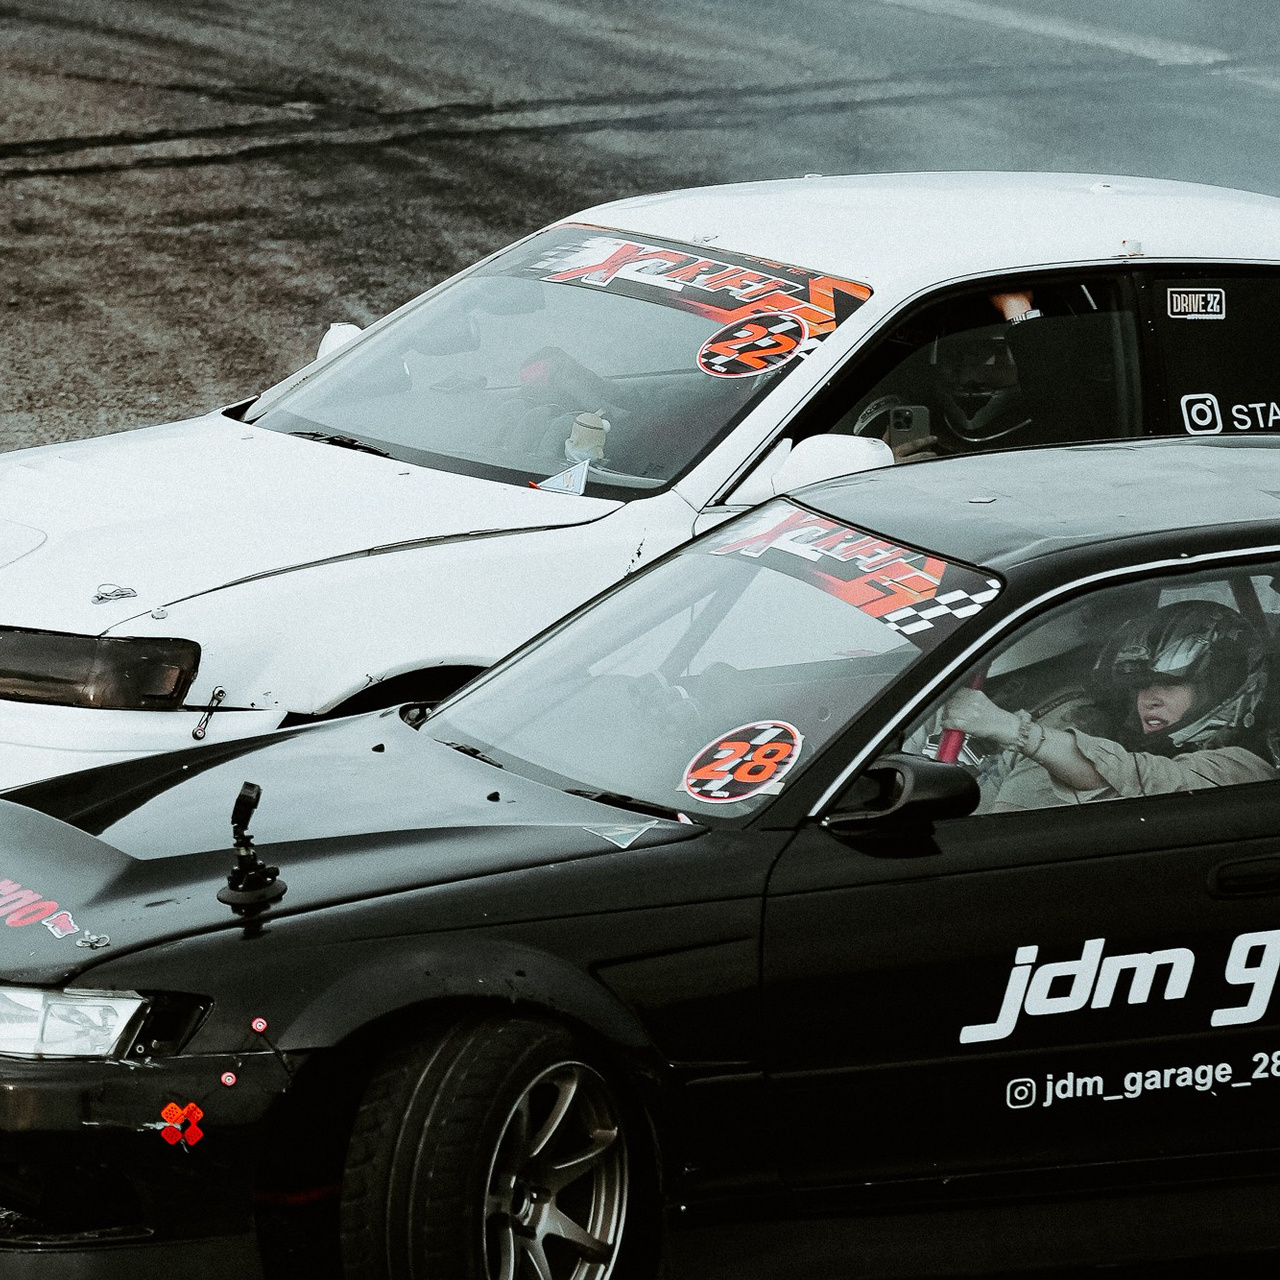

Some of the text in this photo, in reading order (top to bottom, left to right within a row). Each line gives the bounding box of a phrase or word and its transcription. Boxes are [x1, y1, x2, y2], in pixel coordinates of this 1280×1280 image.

[1172, 294, 1206, 312] DRIVE
[706, 323, 798, 369] 22
[1231, 402, 1280, 430] STA
[688, 741, 795, 783] 28
[960, 938, 1195, 1044] jdm
